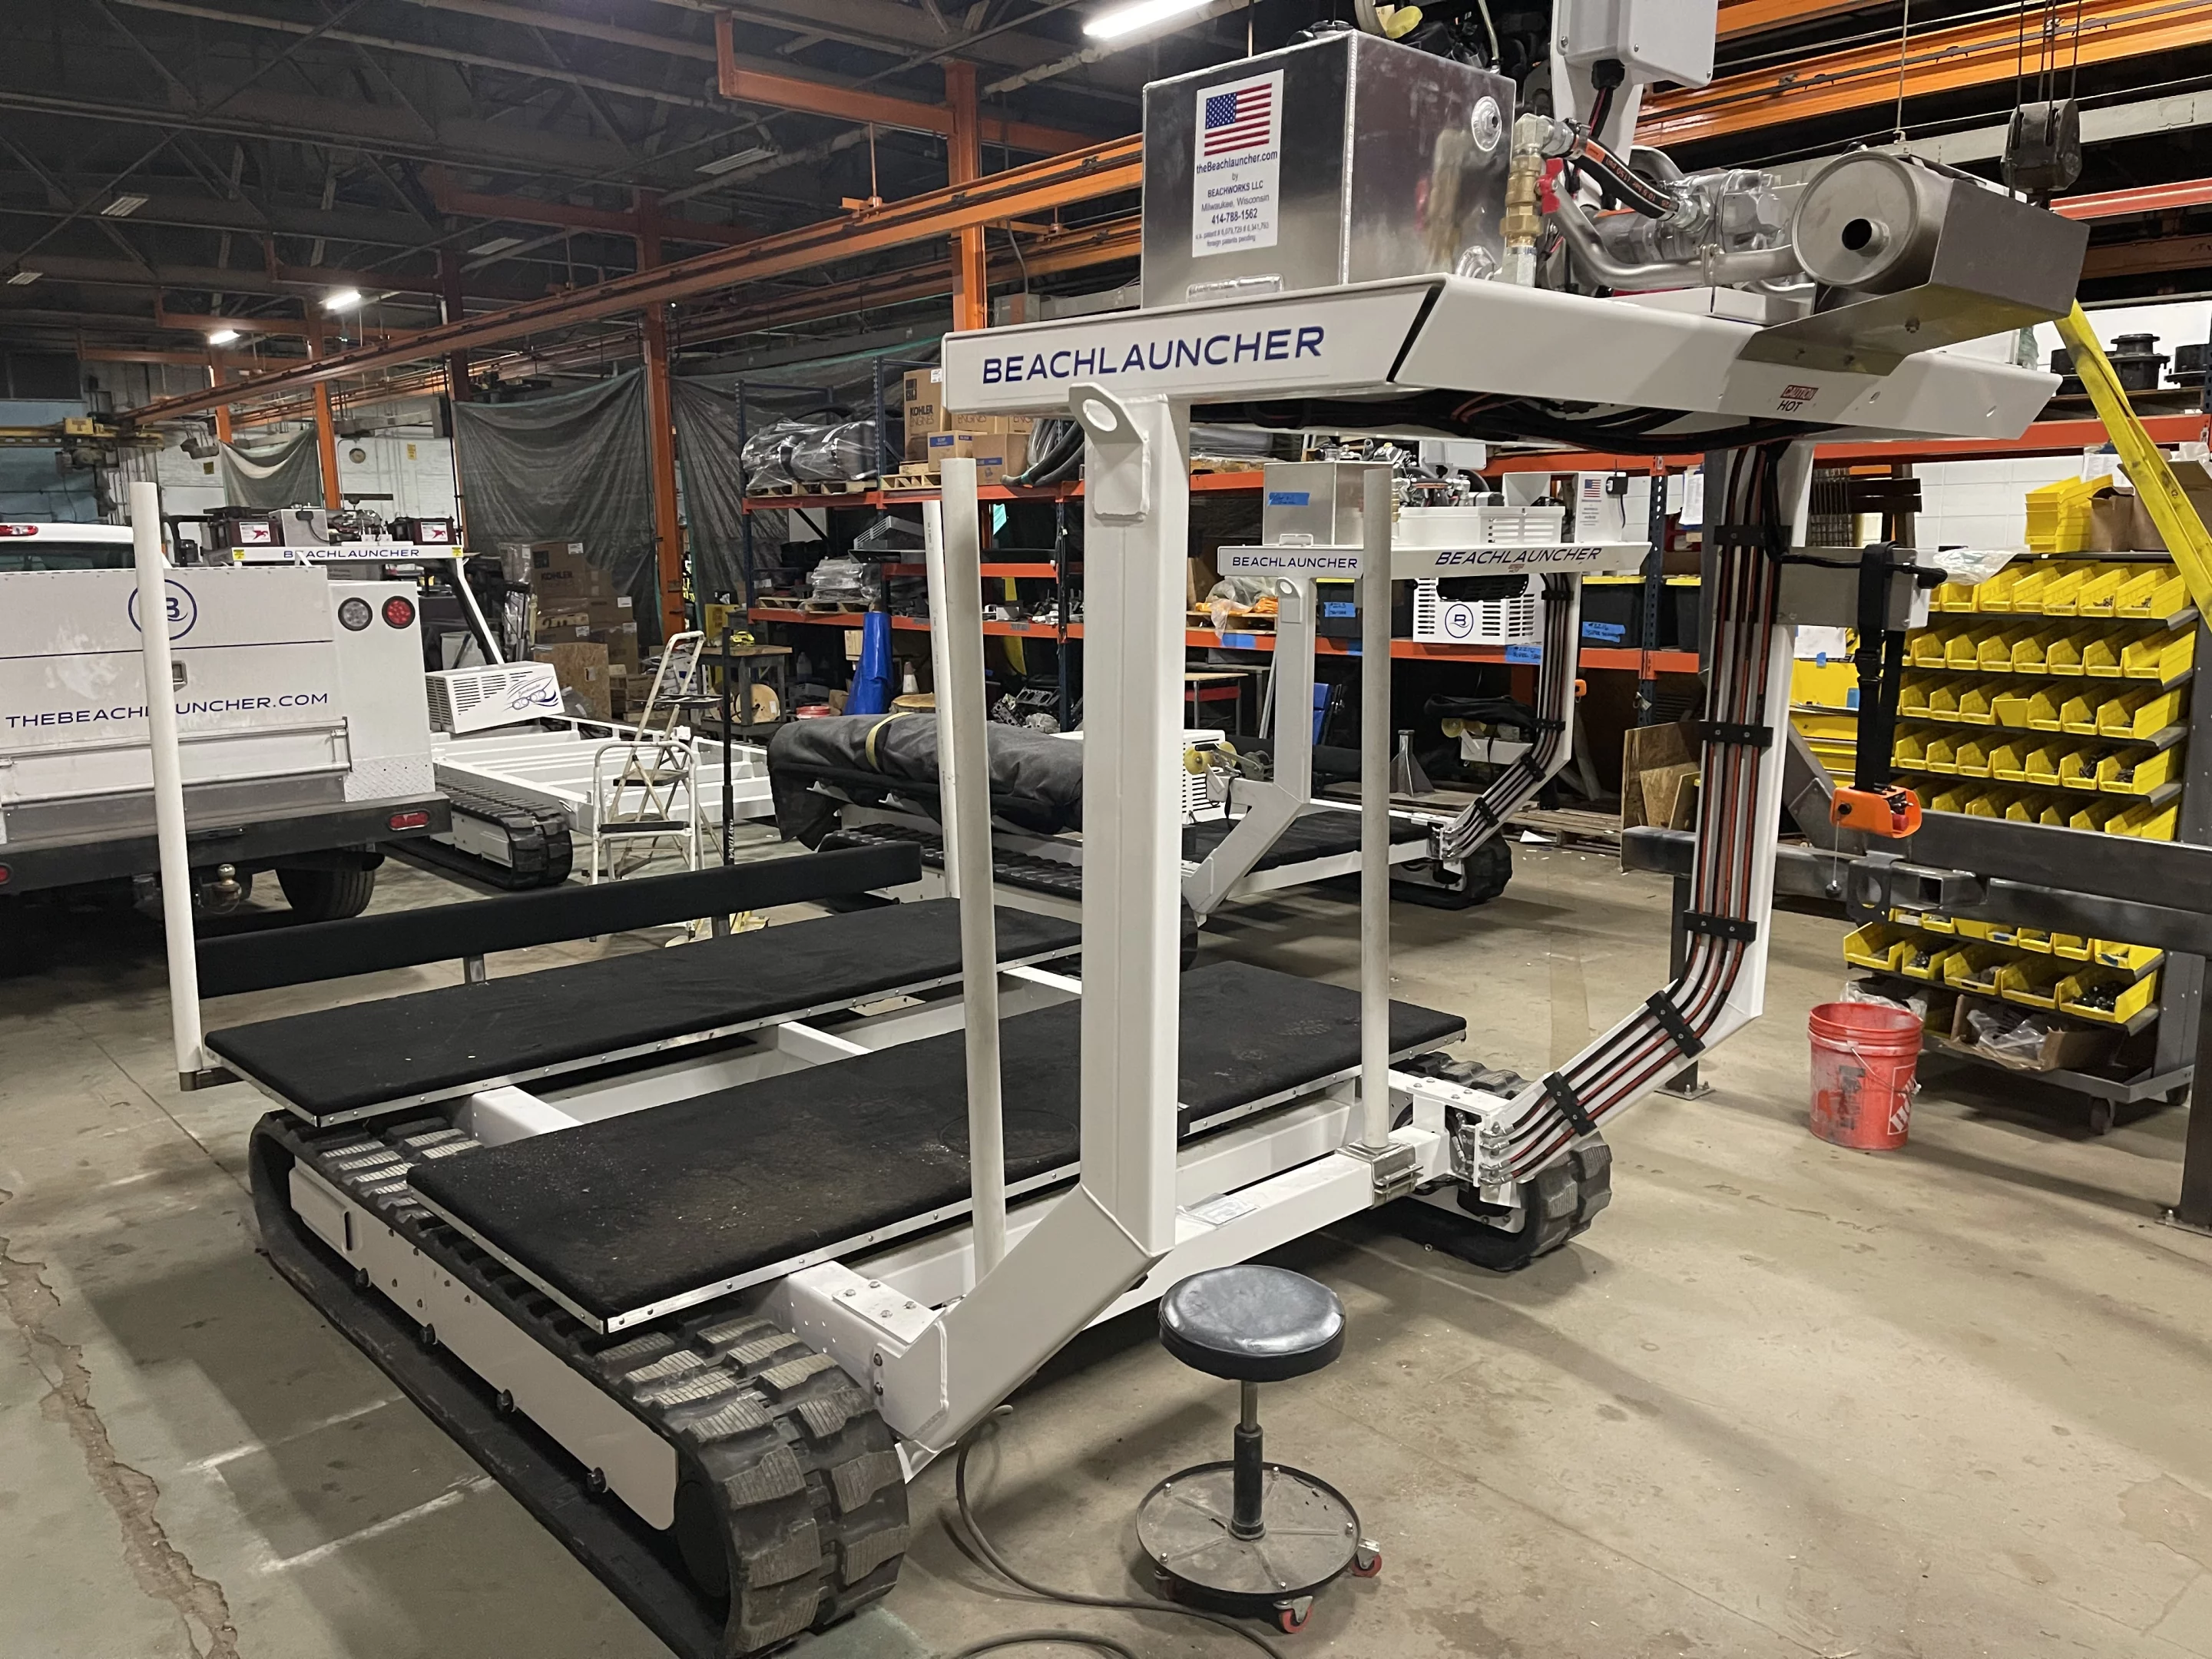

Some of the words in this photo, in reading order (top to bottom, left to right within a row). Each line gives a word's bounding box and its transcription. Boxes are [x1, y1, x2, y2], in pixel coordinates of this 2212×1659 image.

[1197, 151, 1278, 174] theBeachlauncher.com
[1232, 173, 1239, 181] by
[1617, 169, 1631, 182] (150
[1207, 183, 1250, 197] BEACHWORKS
[1251, 180, 1263, 190] LLC
[1237, 194, 1270, 206] Wisconsin
[1211, 208, 1258, 225] 414-788-1562
[982, 326, 1325, 383] BEACHLAUNCHER
[910, 405, 933, 416] KOHLER
[1777, 400, 1803, 412] HOT
[909, 415, 934, 427] ENGINES
[283, 549, 419, 558] BACHLAUNCHER
[1435, 548, 1602, 565] BEACHLAUNCHER
[1232, 557, 1358, 568] BEACHLAUNCHER
[5, 693, 329, 729] THEBEACHUNCHER.COM
